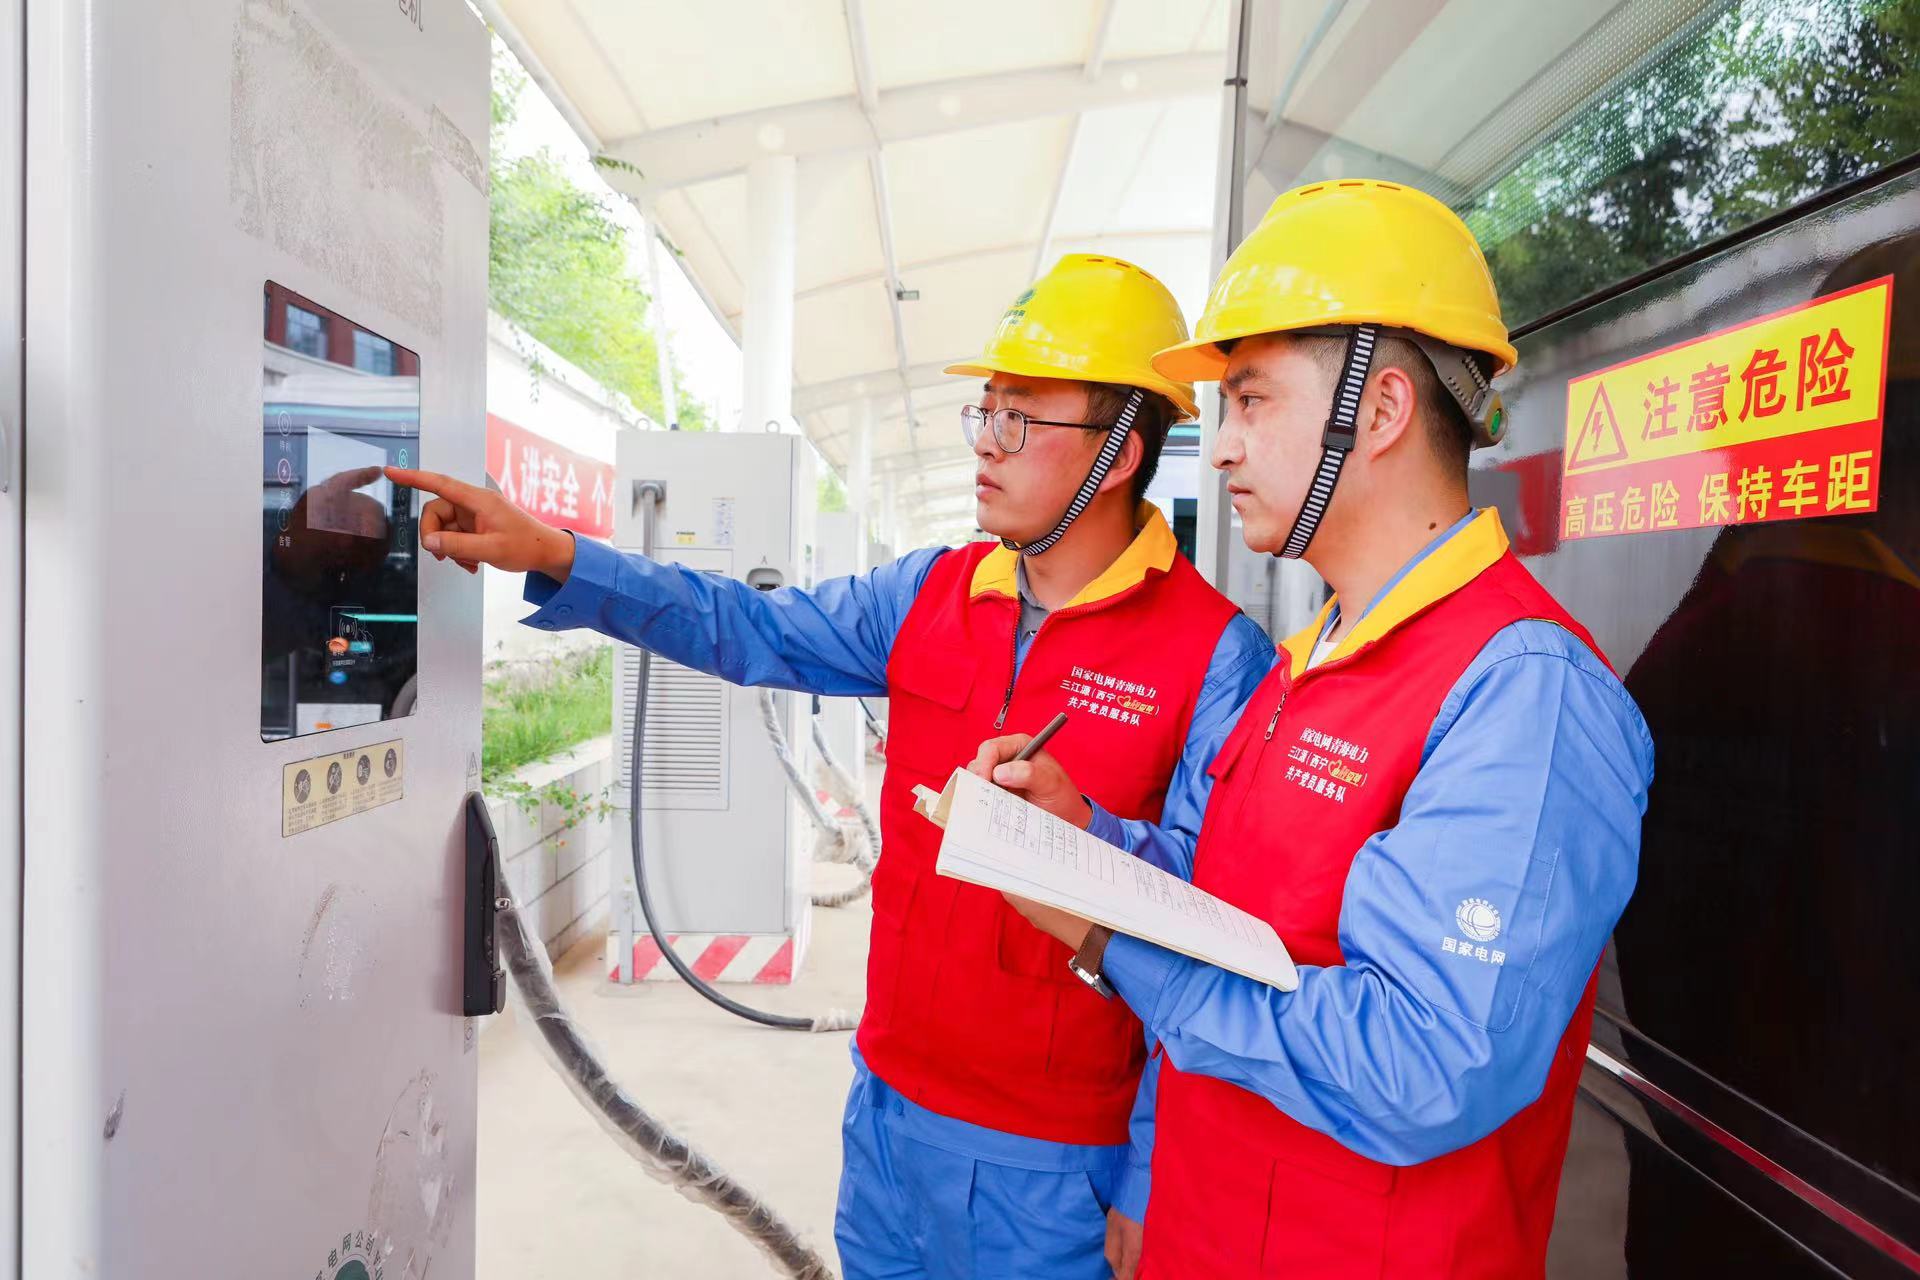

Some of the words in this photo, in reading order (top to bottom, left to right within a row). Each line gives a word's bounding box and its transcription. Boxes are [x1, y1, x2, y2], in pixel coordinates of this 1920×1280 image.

[1640, 327, 1856, 442] 注意危险
[499, 438, 580, 519] 人讲安全
[1564, 479, 1680, 538] 高压危险
[1698, 449, 1873, 523] 保持车距
[1071, 665, 1157, 699] 国家电网青海电力
[1067, 696, 1141, 727] 共产党员服务队
[1299, 727, 1369, 764] 国家电网青海电力
[1284, 765, 1347, 803] 共产党员服务队
[1441, 936, 1506, 966] 国家电网
